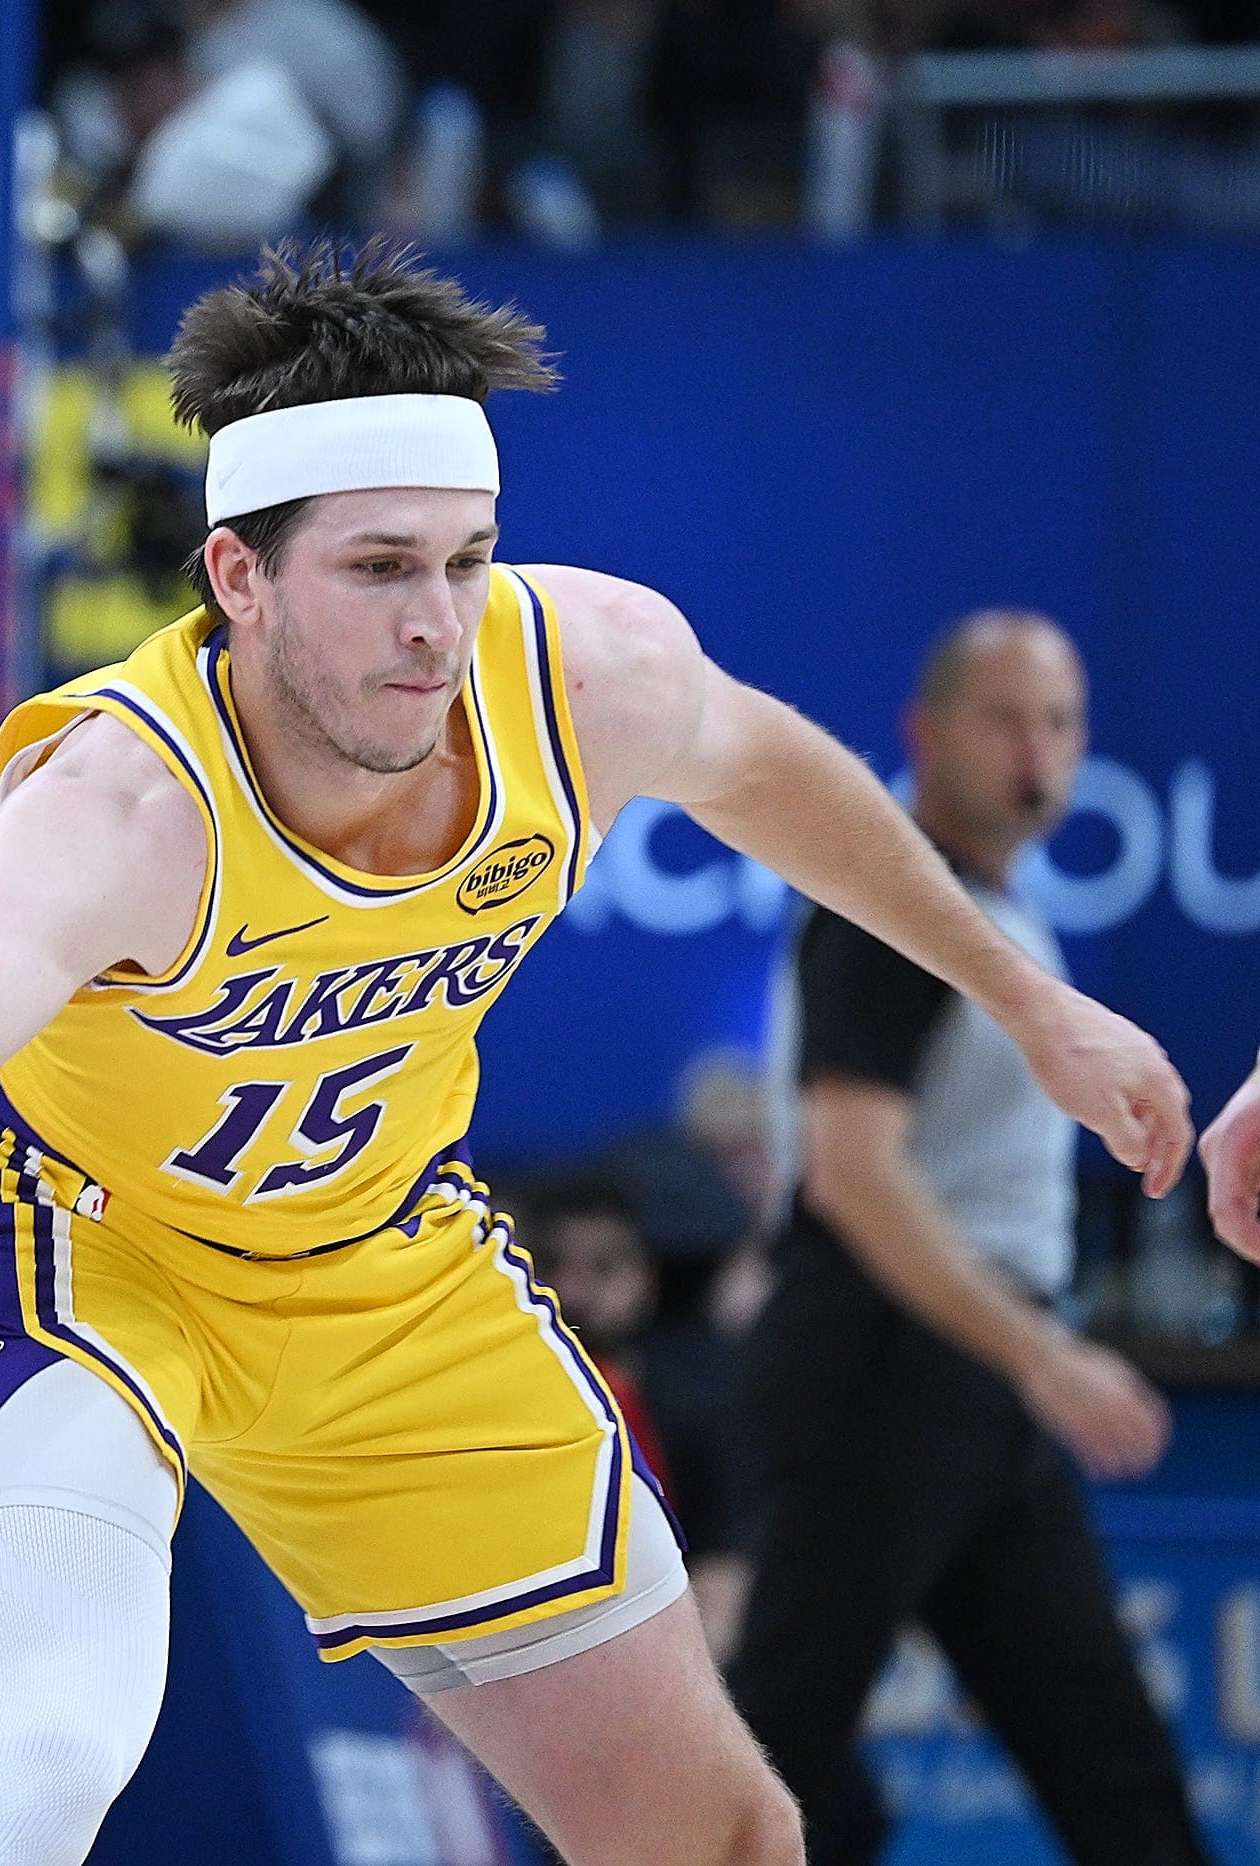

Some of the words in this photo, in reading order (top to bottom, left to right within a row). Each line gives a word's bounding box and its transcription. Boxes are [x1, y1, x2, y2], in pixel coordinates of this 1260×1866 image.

[466, 852, 548, 893] bibigo
[124, 913, 546, 1059] LAKERS
[158, 1041, 419, 1206] 15
